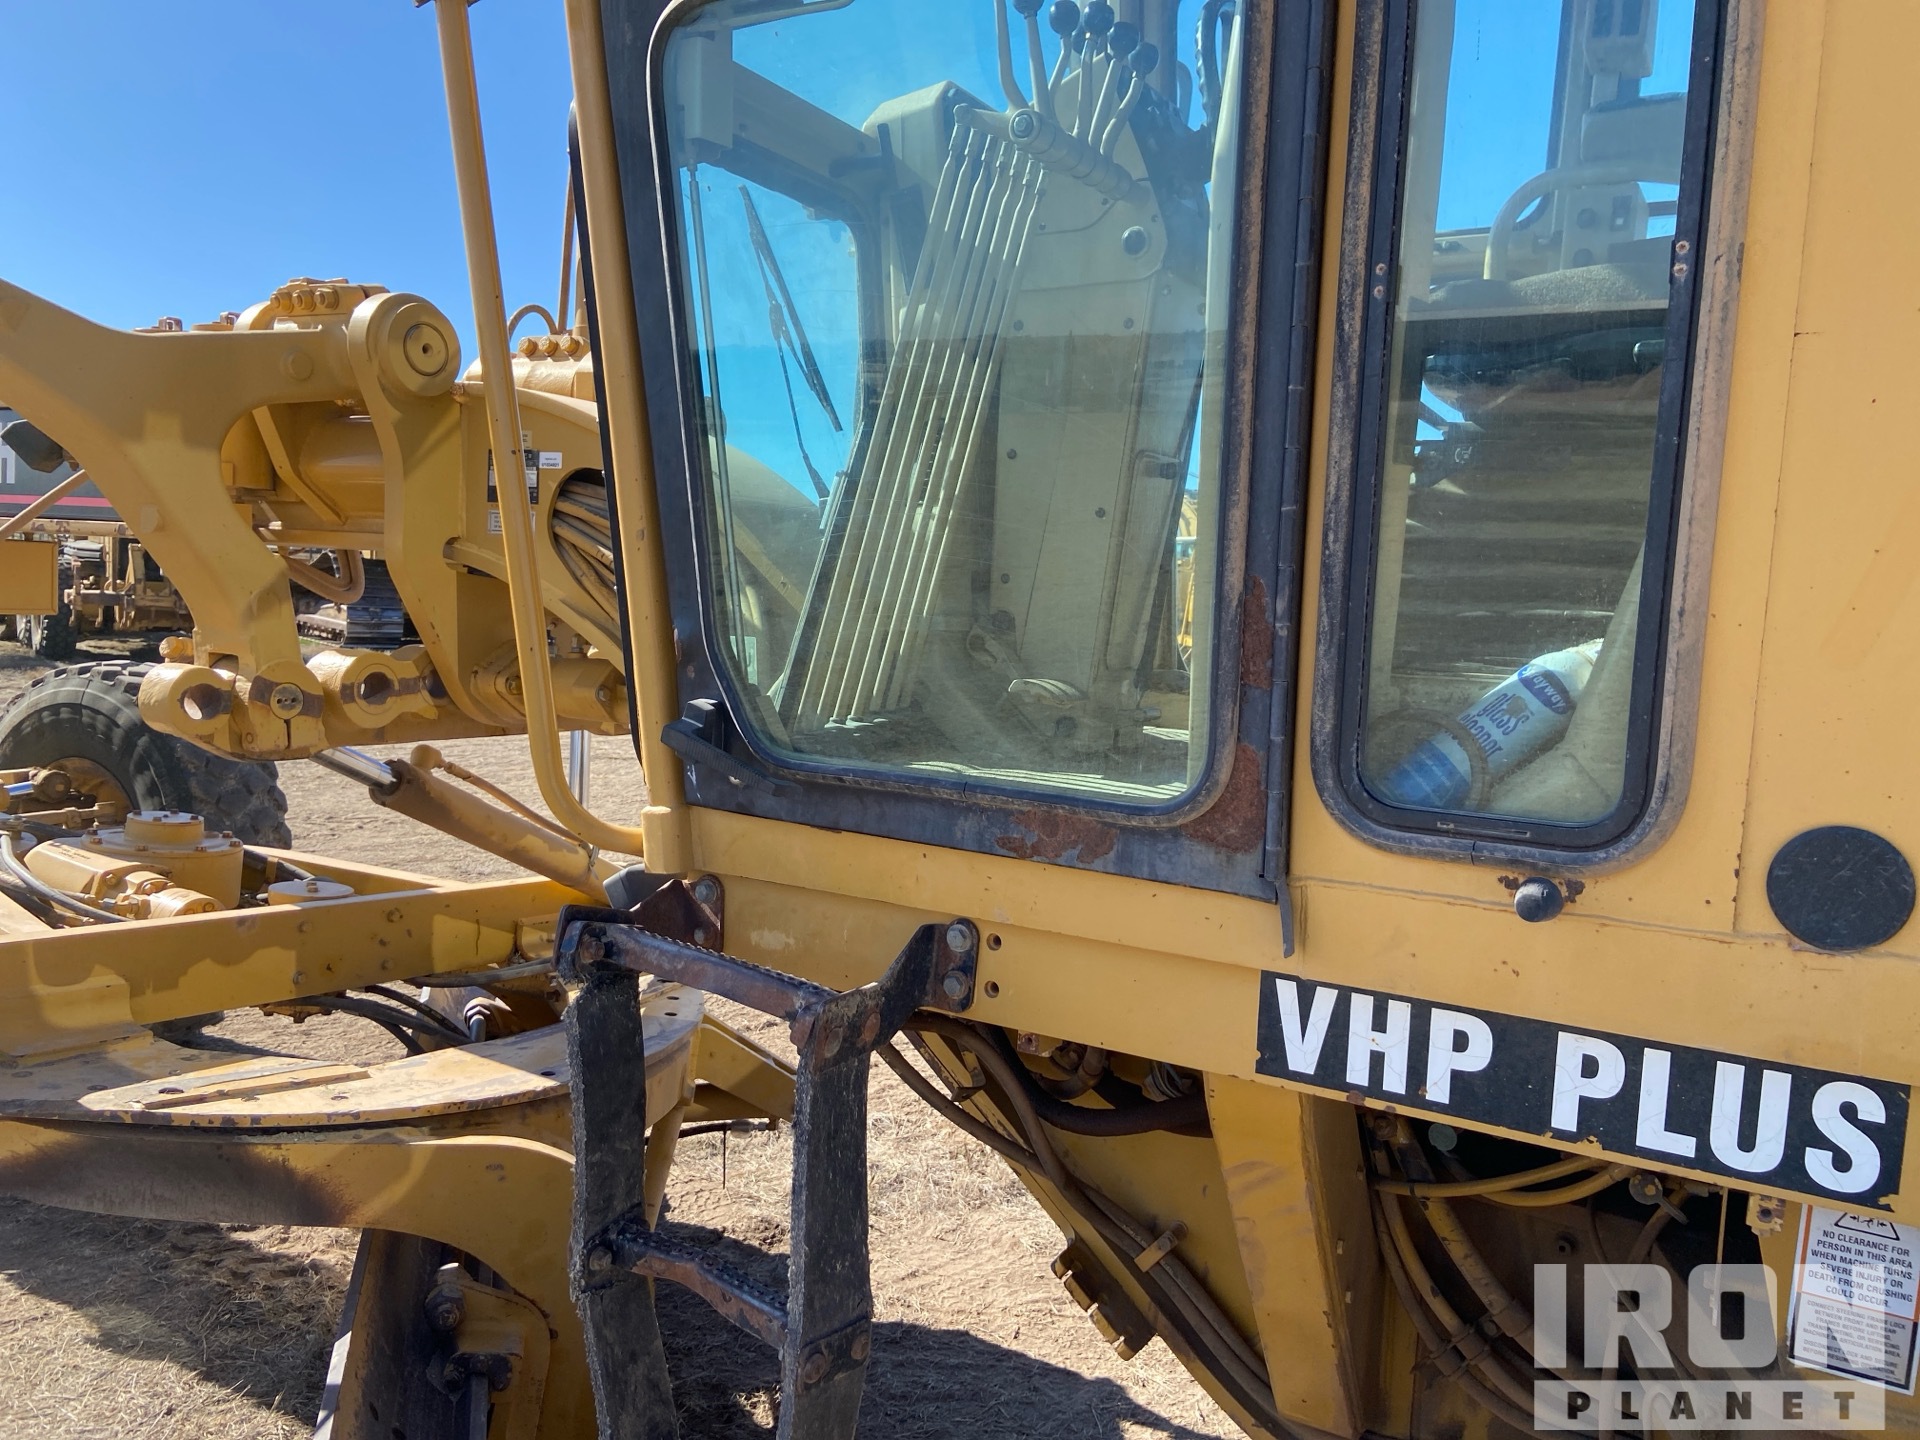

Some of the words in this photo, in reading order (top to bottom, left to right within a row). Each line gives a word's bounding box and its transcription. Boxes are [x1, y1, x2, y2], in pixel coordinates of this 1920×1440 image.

[1275, 978, 1493, 1104] VHP
[1550, 1031, 1887, 1194] PLUS
[1817, 1239, 1852, 1255] PERSON
[1854, 1249, 1864, 1257] IN
[1866, 1250, 1887, 1263] THIS
[1889, 1257, 1913, 1269] AREA
[1822, 1229, 1835, 1239] NO
[1837, 1233, 1890, 1253] CLEARANCE
[1891, 1246, 1910, 1257] FOR
[1810, 1249, 1837, 1261] WHEN
[1839, 1255, 1880, 1272] MACHINE
[1808, 1269, 1836, 1283] DEATH
[1838, 1277, 1864, 1291] FROM
[1866, 1284, 1913, 1303] CRUSHING
[1820, 1262, 1853, 1277] SEVERE
[1855, 1271, 1888, 1285] INJURY
[1890, 1279, 1904, 1289] OR
[1825, 1285, 1855, 1299] COULD
